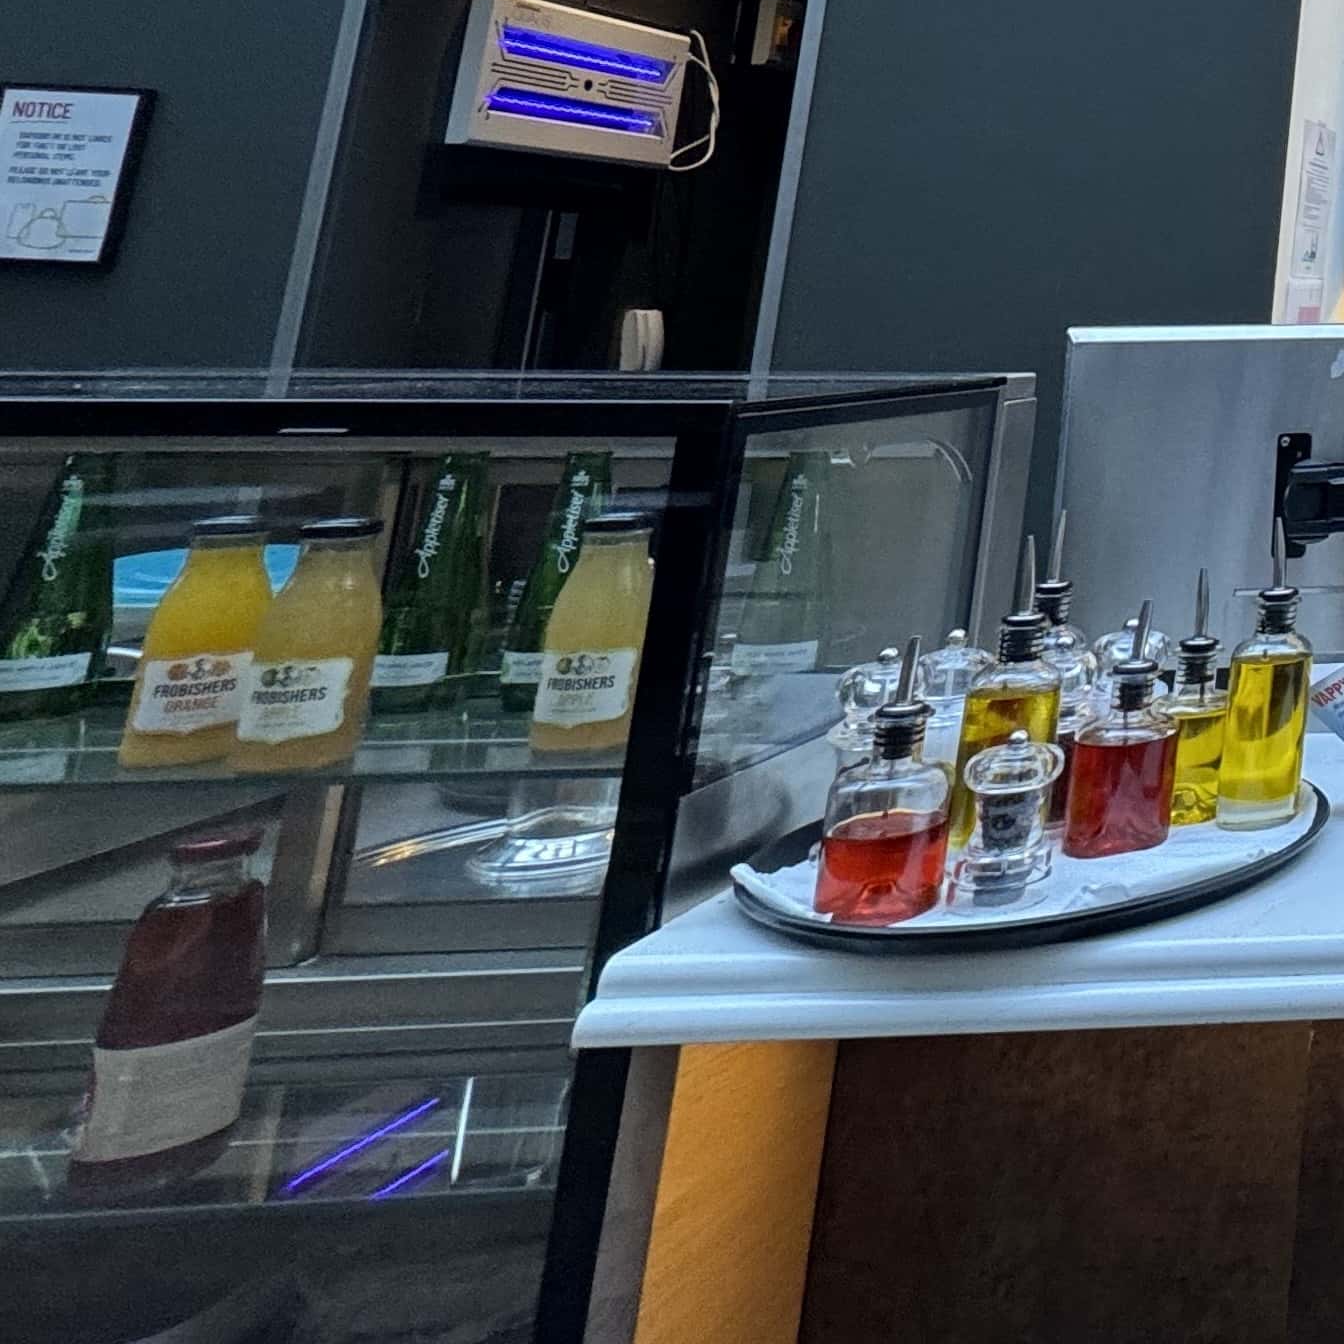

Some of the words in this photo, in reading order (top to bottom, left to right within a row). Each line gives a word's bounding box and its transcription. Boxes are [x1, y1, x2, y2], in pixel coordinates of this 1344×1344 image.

[12, 101, 75, 119] NOTICE
[415, 489, 450, 578] Appletiser
[556, 488, 585, 574] Appletiser
[777, 489, 804, 576] Appletiser
[153, 677, 237, 699] FROBISHERS
[547, 673, 616, 691] FROBISHERS
[252, 686, 328, 706] FROBISHERS
